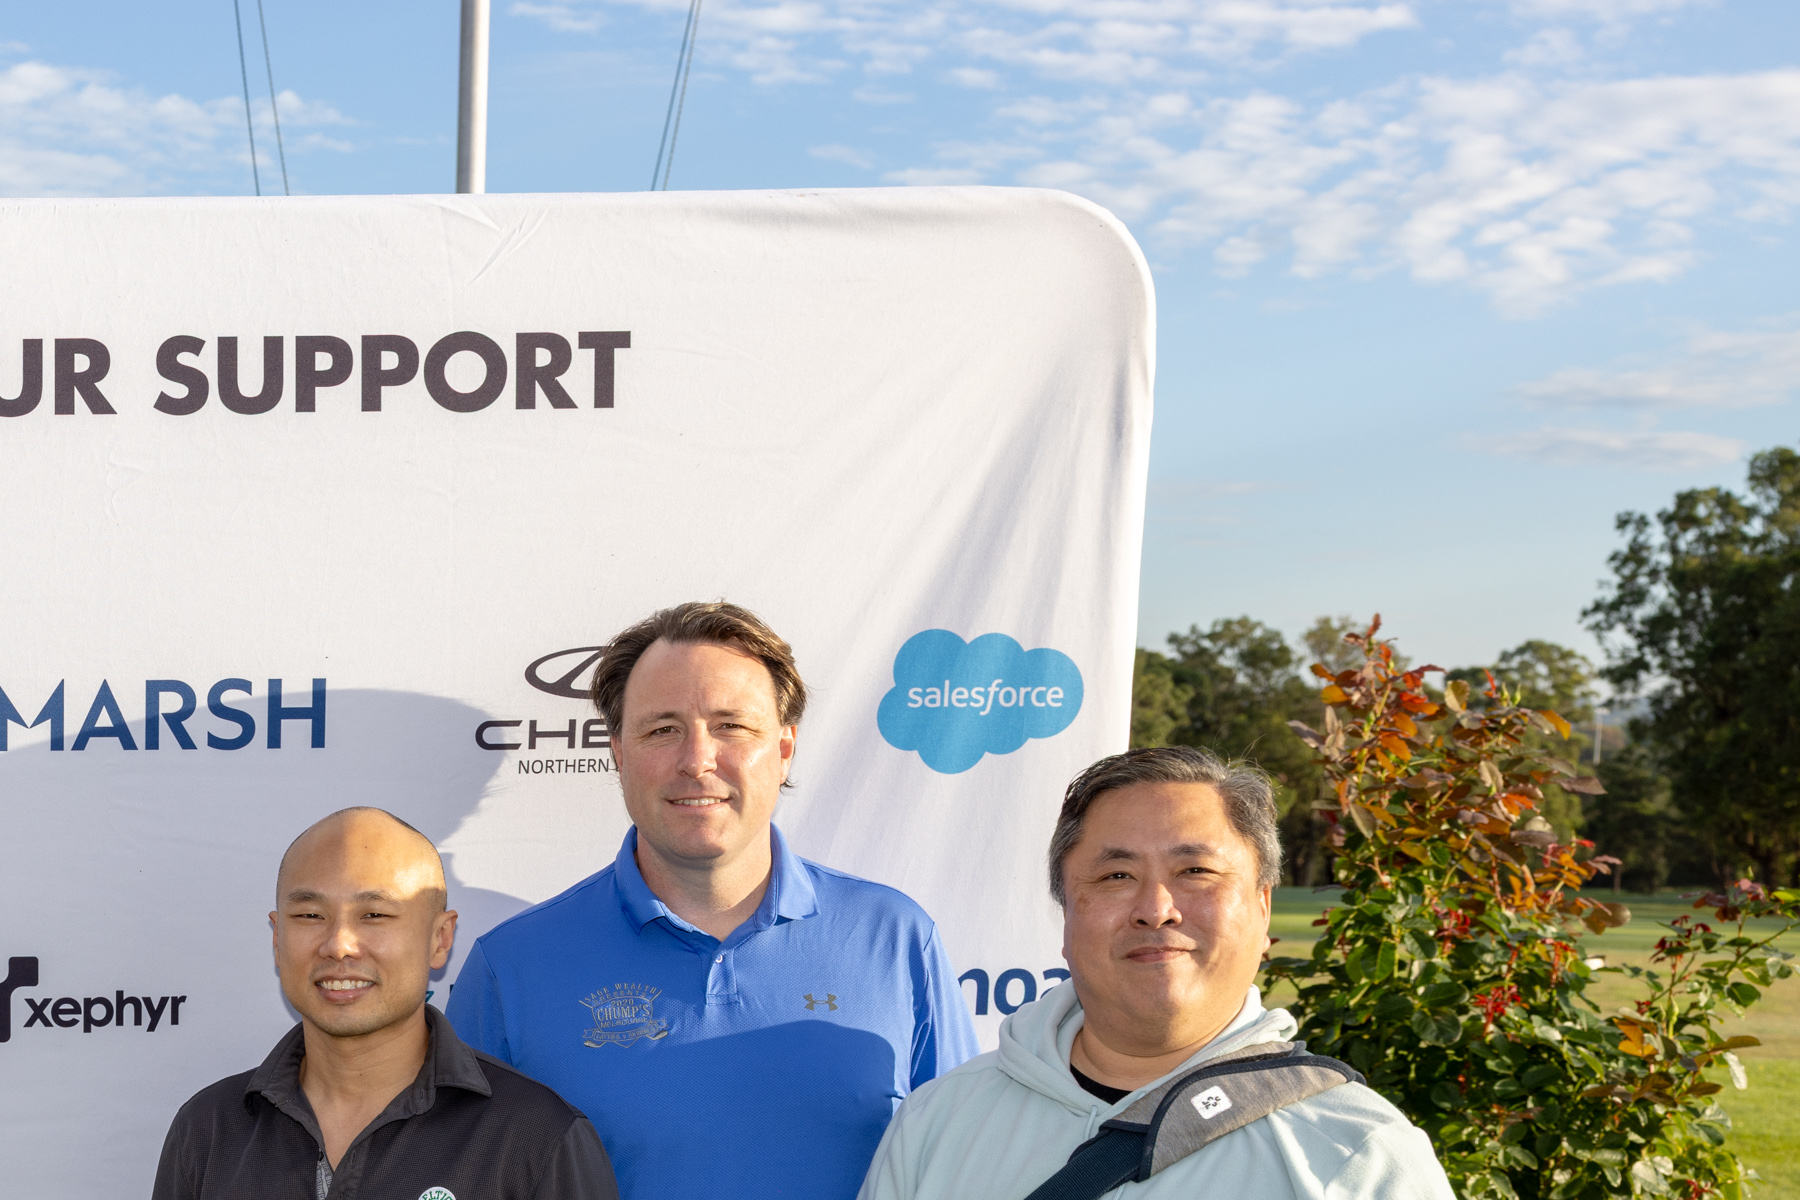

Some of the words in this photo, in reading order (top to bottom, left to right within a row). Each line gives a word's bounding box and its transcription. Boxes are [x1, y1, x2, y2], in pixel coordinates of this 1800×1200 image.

[152, 330, 632, 416] SUPPORT
[906, 679, 1064, 716] salesforce
[475, 718, 612, 751] CHE
[518, 758, 610, 775] NORTHERN
[614, 982, 657, 994] WEALTH
[23, 990, 188, 1033] xephyr
[597, 1004, 650, 1021] CHUMP'S
